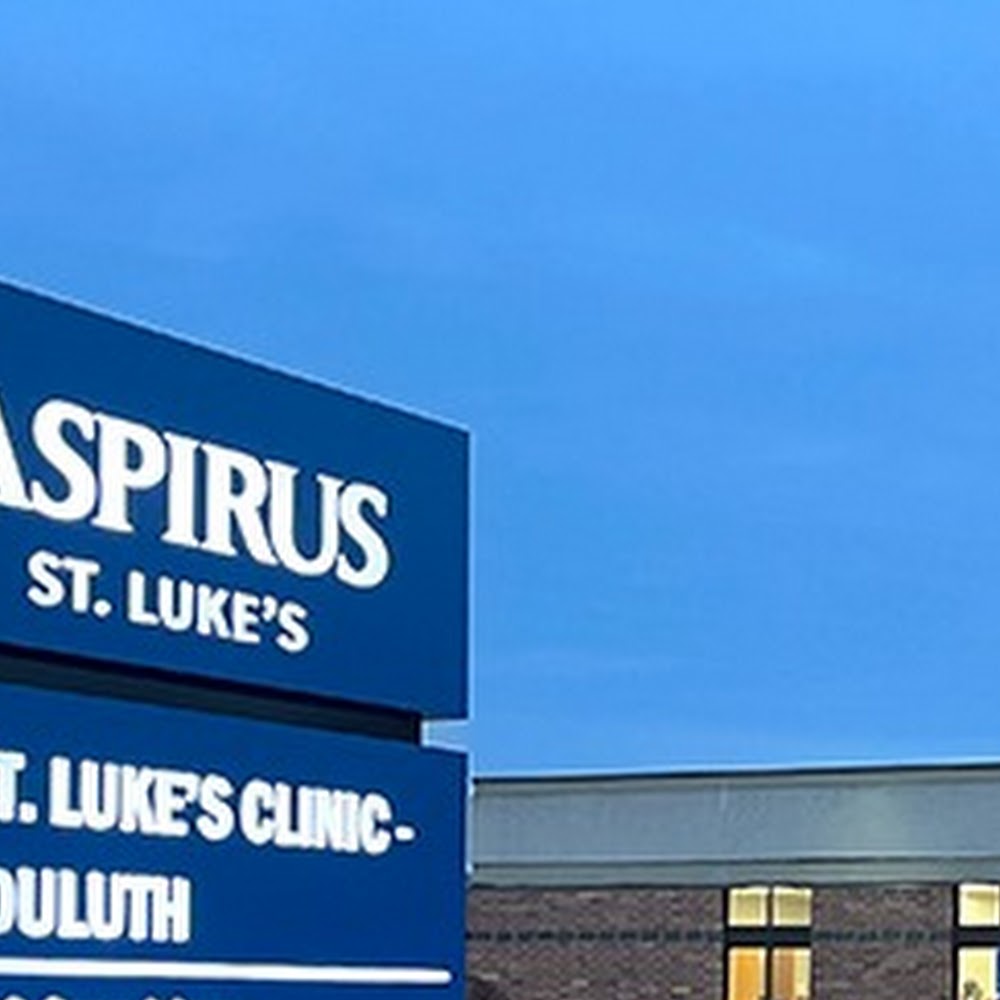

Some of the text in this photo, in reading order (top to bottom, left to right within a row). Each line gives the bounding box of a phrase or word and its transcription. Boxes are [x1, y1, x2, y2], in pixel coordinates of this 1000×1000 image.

[27, 549, 310, 653] ST. LUKE'S
[49, 756, 235, 842] LUKE'S
